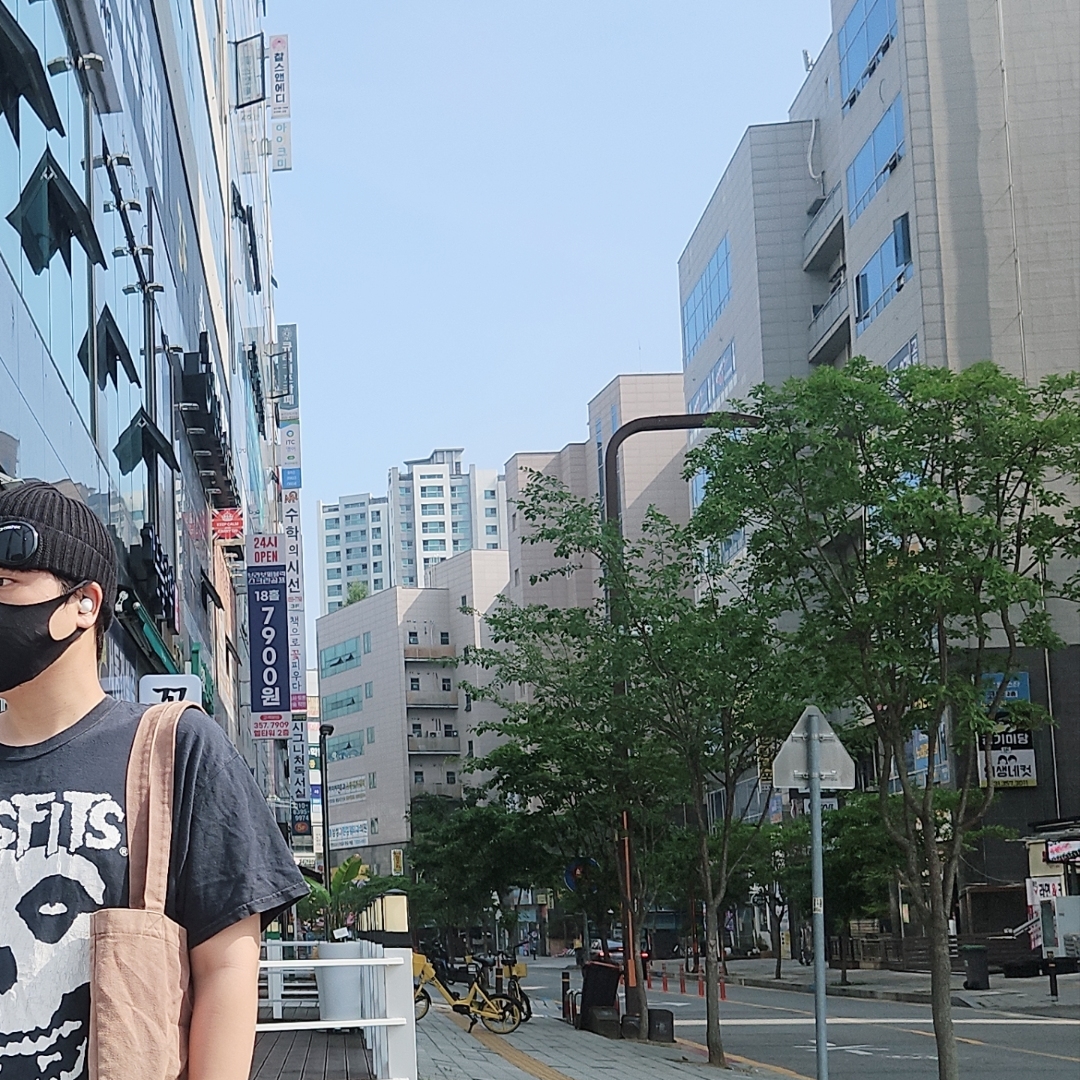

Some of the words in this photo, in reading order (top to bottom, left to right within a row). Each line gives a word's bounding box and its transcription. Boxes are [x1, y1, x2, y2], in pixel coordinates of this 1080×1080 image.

[253, 536, 278, 549] 24시
[254, 551, 278, 563] OPEN
[260, 606, 281, 706] 7900원
[292, 721, 307, 799] 시그니처독서실
